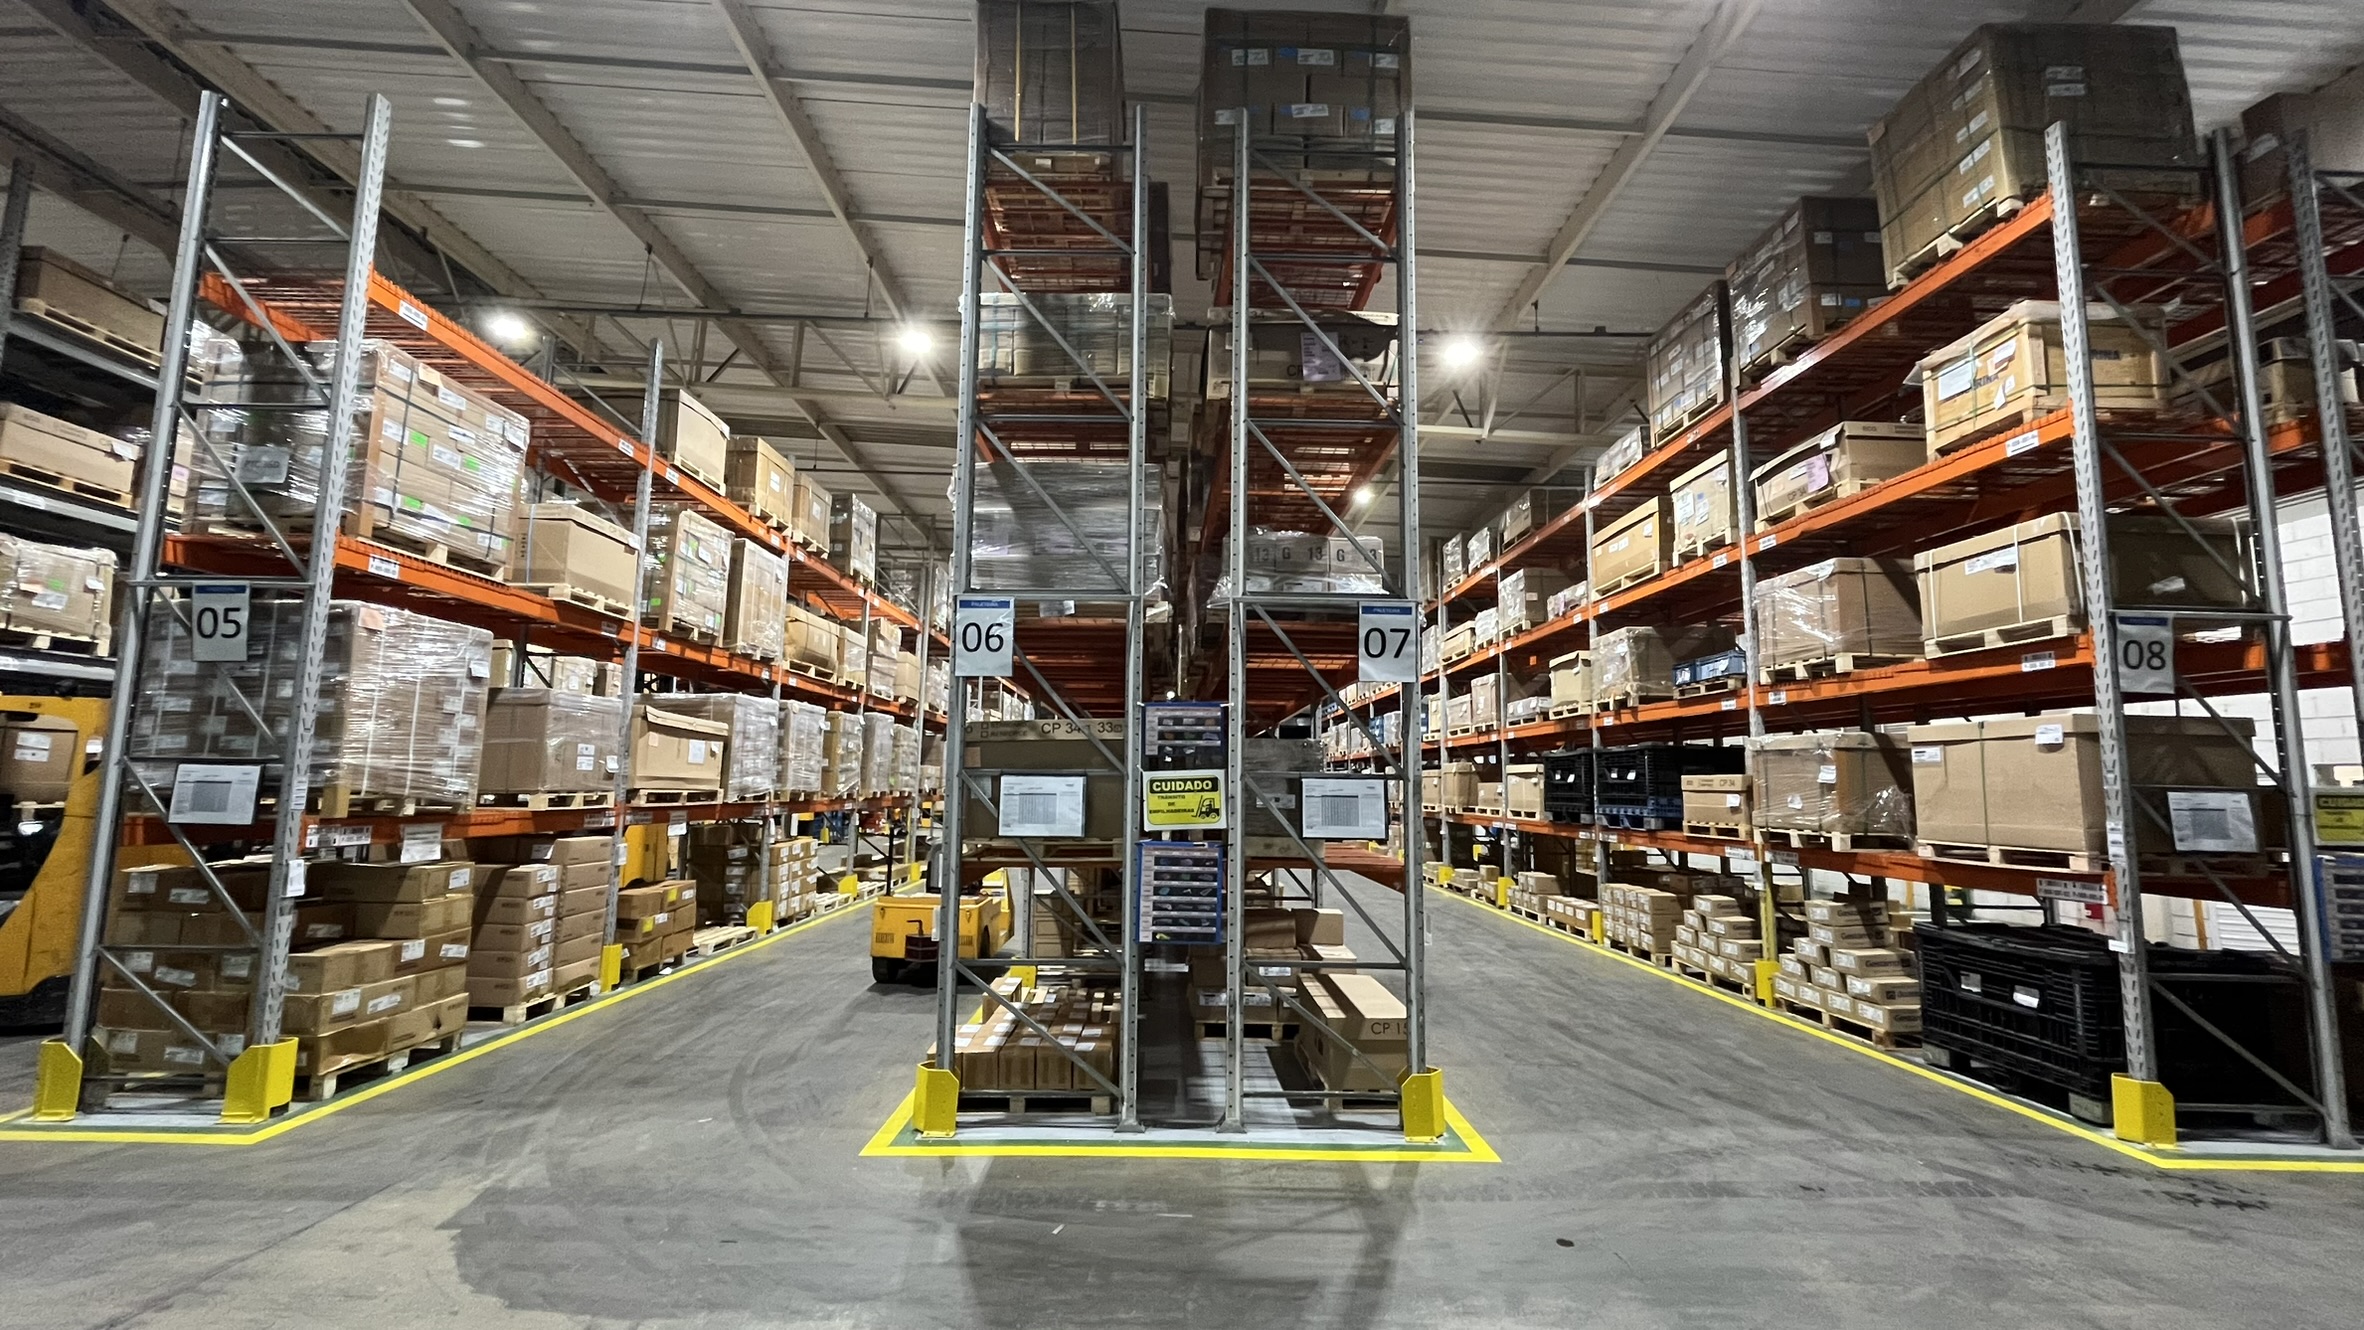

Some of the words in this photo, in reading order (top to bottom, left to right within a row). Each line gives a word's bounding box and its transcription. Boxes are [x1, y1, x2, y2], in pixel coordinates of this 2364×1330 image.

[1282, 547, 1291, 560] G
[1308, 546, 1323, 560] 13
[1336, 549, 1345, 562] G
[196, 607, 242, 639] 05
[961, 622, 1004, 653] 06
[1364, 627, 1411, 659] 07
[2122, 640, 2166, 671] 08
[1041, 723, 1062, 735] CP
[1097, 722, 1113, 733] 33
[1152, 780, 1213, 792] CUIDADO
[1371, 1022, 1390, 1035] CP
